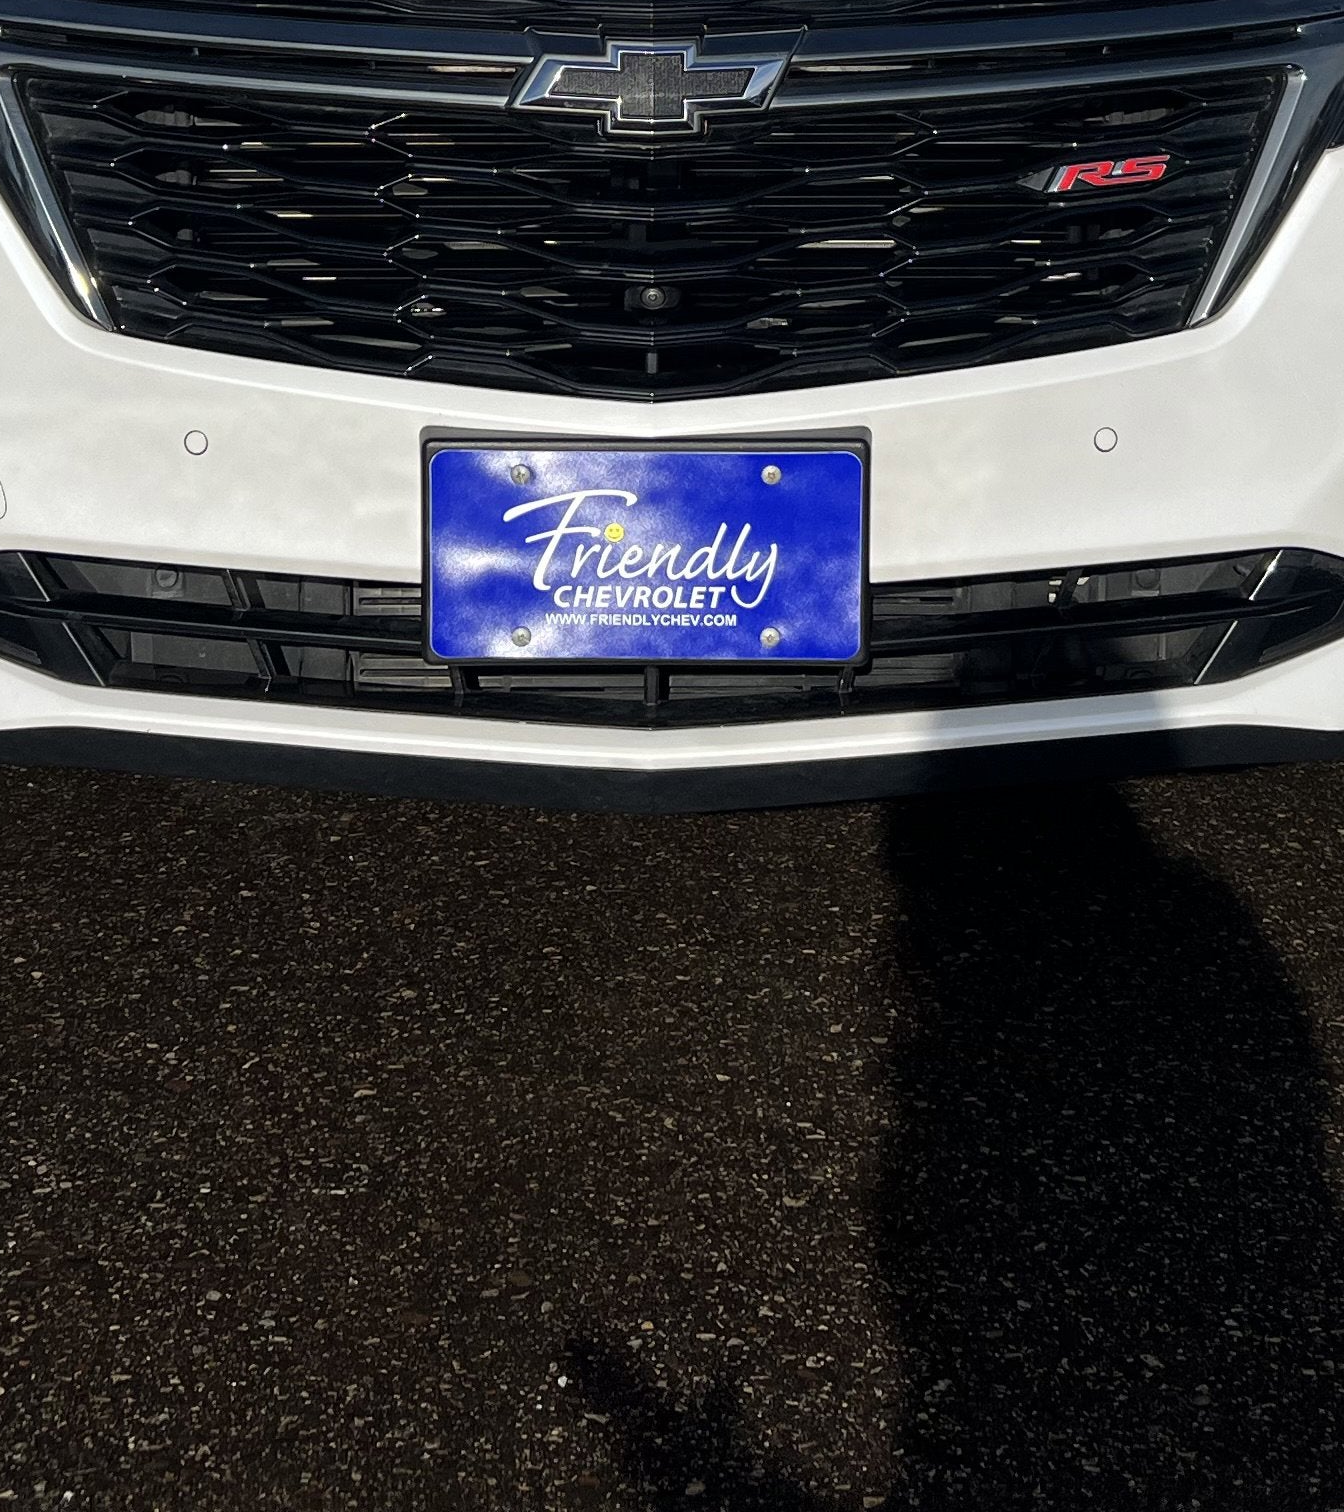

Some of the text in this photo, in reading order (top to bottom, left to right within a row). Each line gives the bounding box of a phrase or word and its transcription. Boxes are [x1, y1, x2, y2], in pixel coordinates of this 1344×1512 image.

[1048, 155, 1170, 193] RS
[503, 488, 778, 609] Friendly
[553, 586, 726, 609] CHEVROLET
[545, 613, 737, 627] WWW.FRIENDLYCHEV.COM
